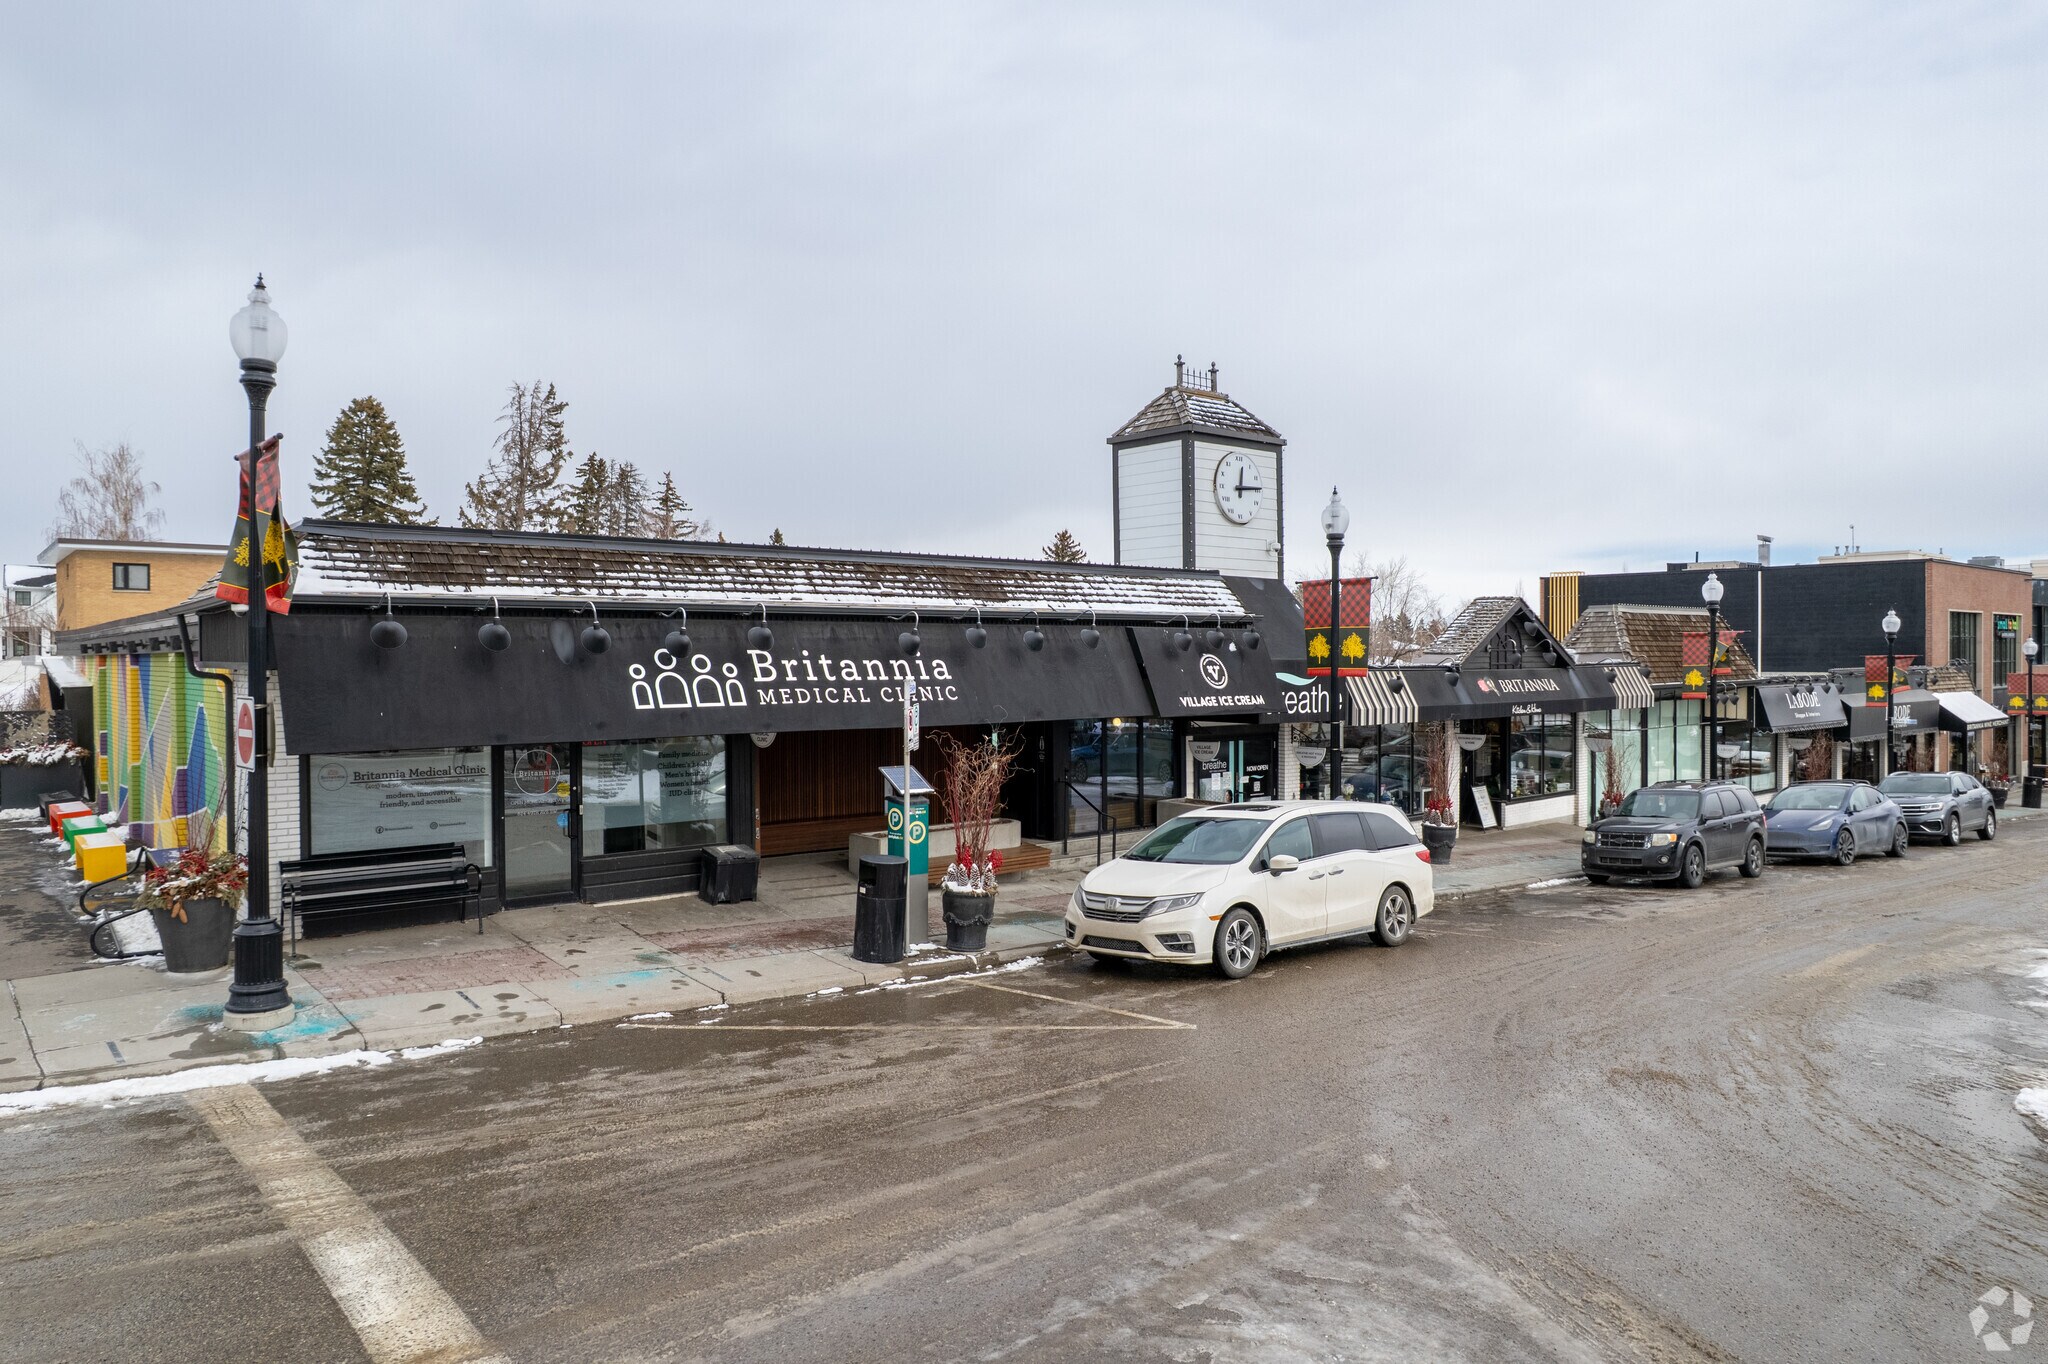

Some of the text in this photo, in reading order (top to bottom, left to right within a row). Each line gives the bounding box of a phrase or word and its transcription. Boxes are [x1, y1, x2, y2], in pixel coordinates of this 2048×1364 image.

[746, 648, 953, 682] Britannia
[1498, 678, 1560, 693] BRITANNIA
[757, 687, 871, 705] MEDICAL
[1179, 694, 1265, 708] VILLAGE ICE CREAM
[658, 751, 680, 759] Family
[657, 761, 690, 770] Children's
[1202, 760, 1227, 770] breathe
[1256, 764, 1269, 772] OPEN
[353, 764, 486, 781] Britannia Medical Clinic
[519, 769, 556, 777] Britannia
[660, 780, 689, 788] Women's
[385, 789, 456, 800] modern, innovative,
[669, 789, 682, 797] IUD
[379, 796, 462, 809] friendly, and accessible
